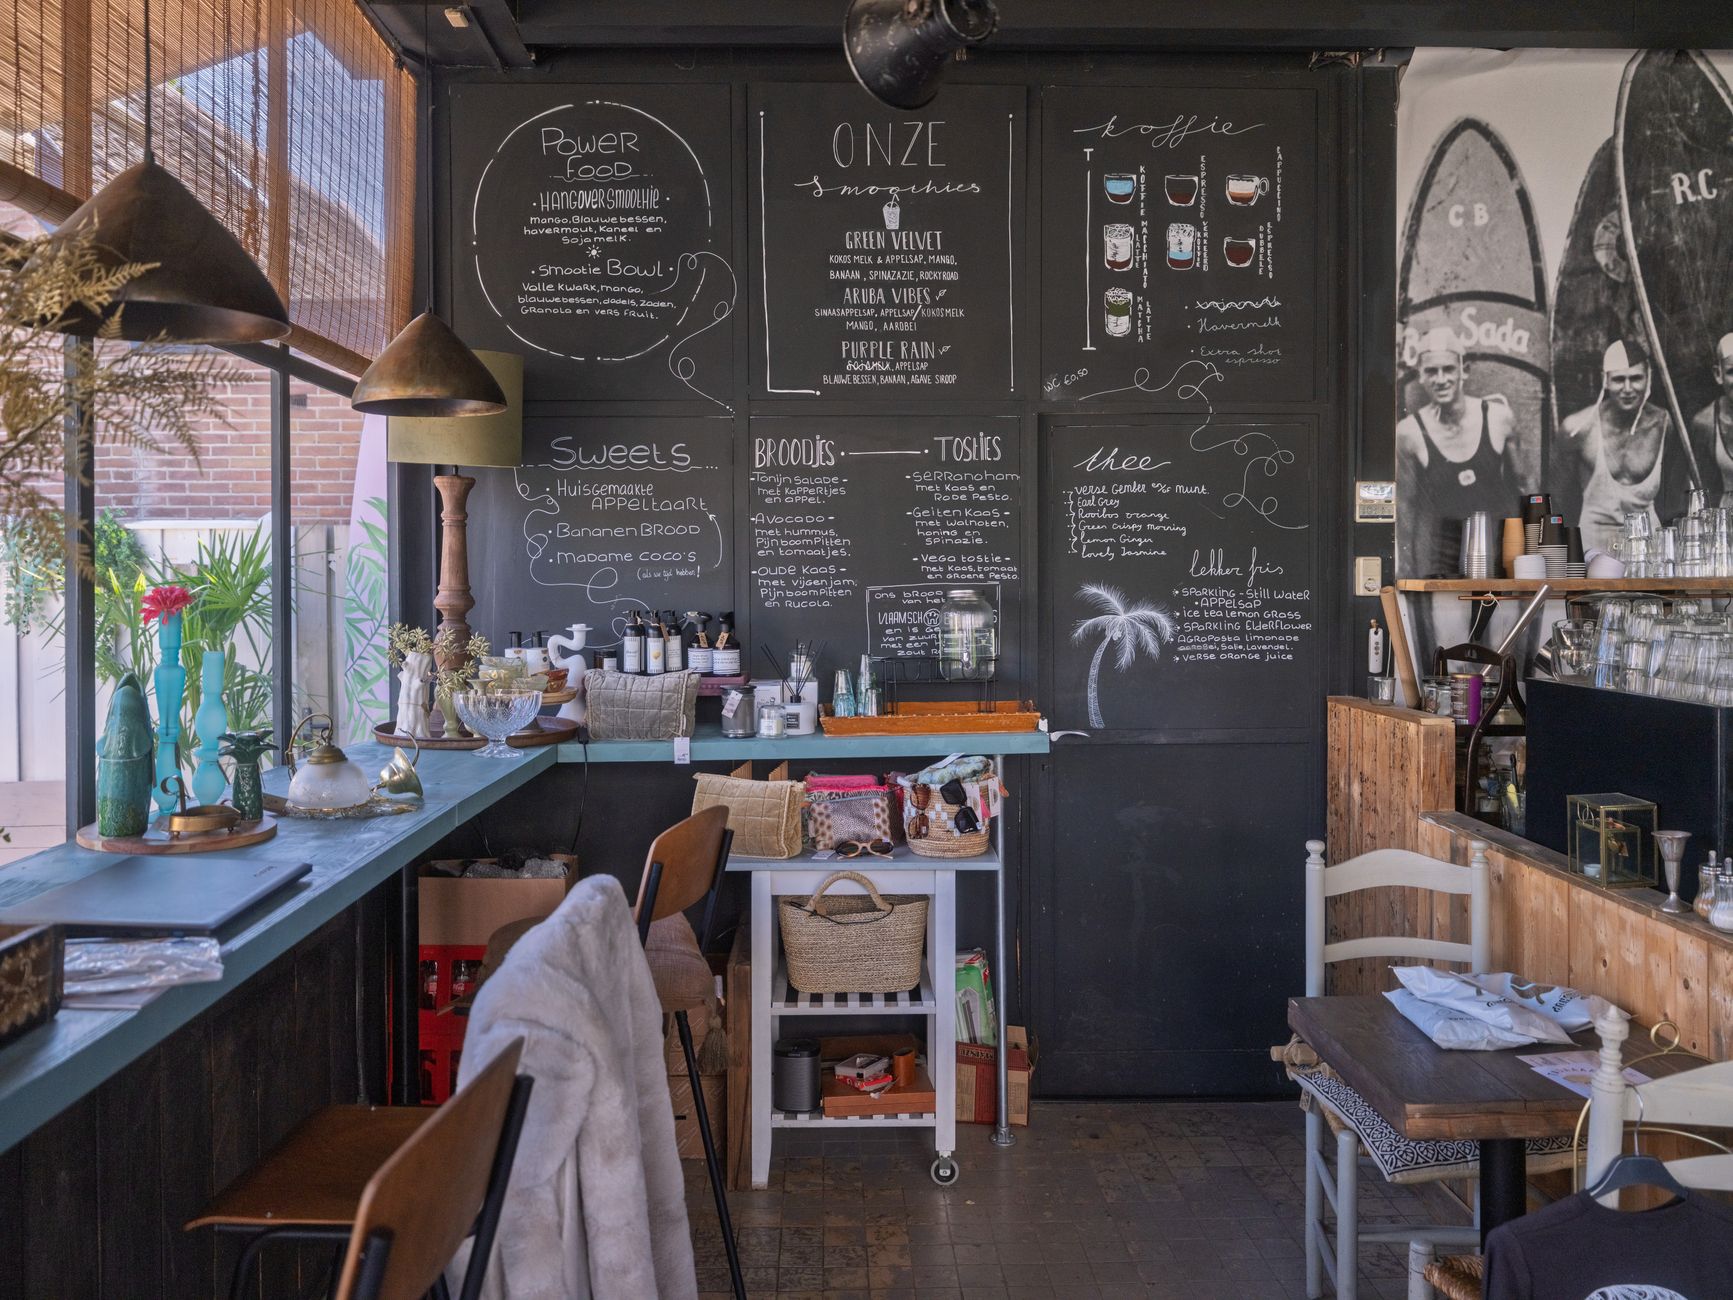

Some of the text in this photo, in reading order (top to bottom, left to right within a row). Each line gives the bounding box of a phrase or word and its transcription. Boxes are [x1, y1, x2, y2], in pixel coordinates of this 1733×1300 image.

[832, 121, 946, 168] ONZE
[1200, 155, 1208, 218] ESPRESSO
[846, 231, 942, 250] GREEN VELVET
[843, 287, 931, 305] ARUBA VIBES
[883, 321, 917, 331] AARDBEI
[1461, 306, 1530, 354] Sada
[842, 341, 935, 359] PURPLE RAIN
[895, 361, 928, 371] APPELSAP
[910, 375, 932, 384] AGAVE
[758, 487, 781, 496] met
[755, 528, 781, 536] met
[758, 578, 786, 586] met
[926, 596, 946, 604] het
[1204, 609, 1223, 617] tea
[880, 641, 902, 649] met
